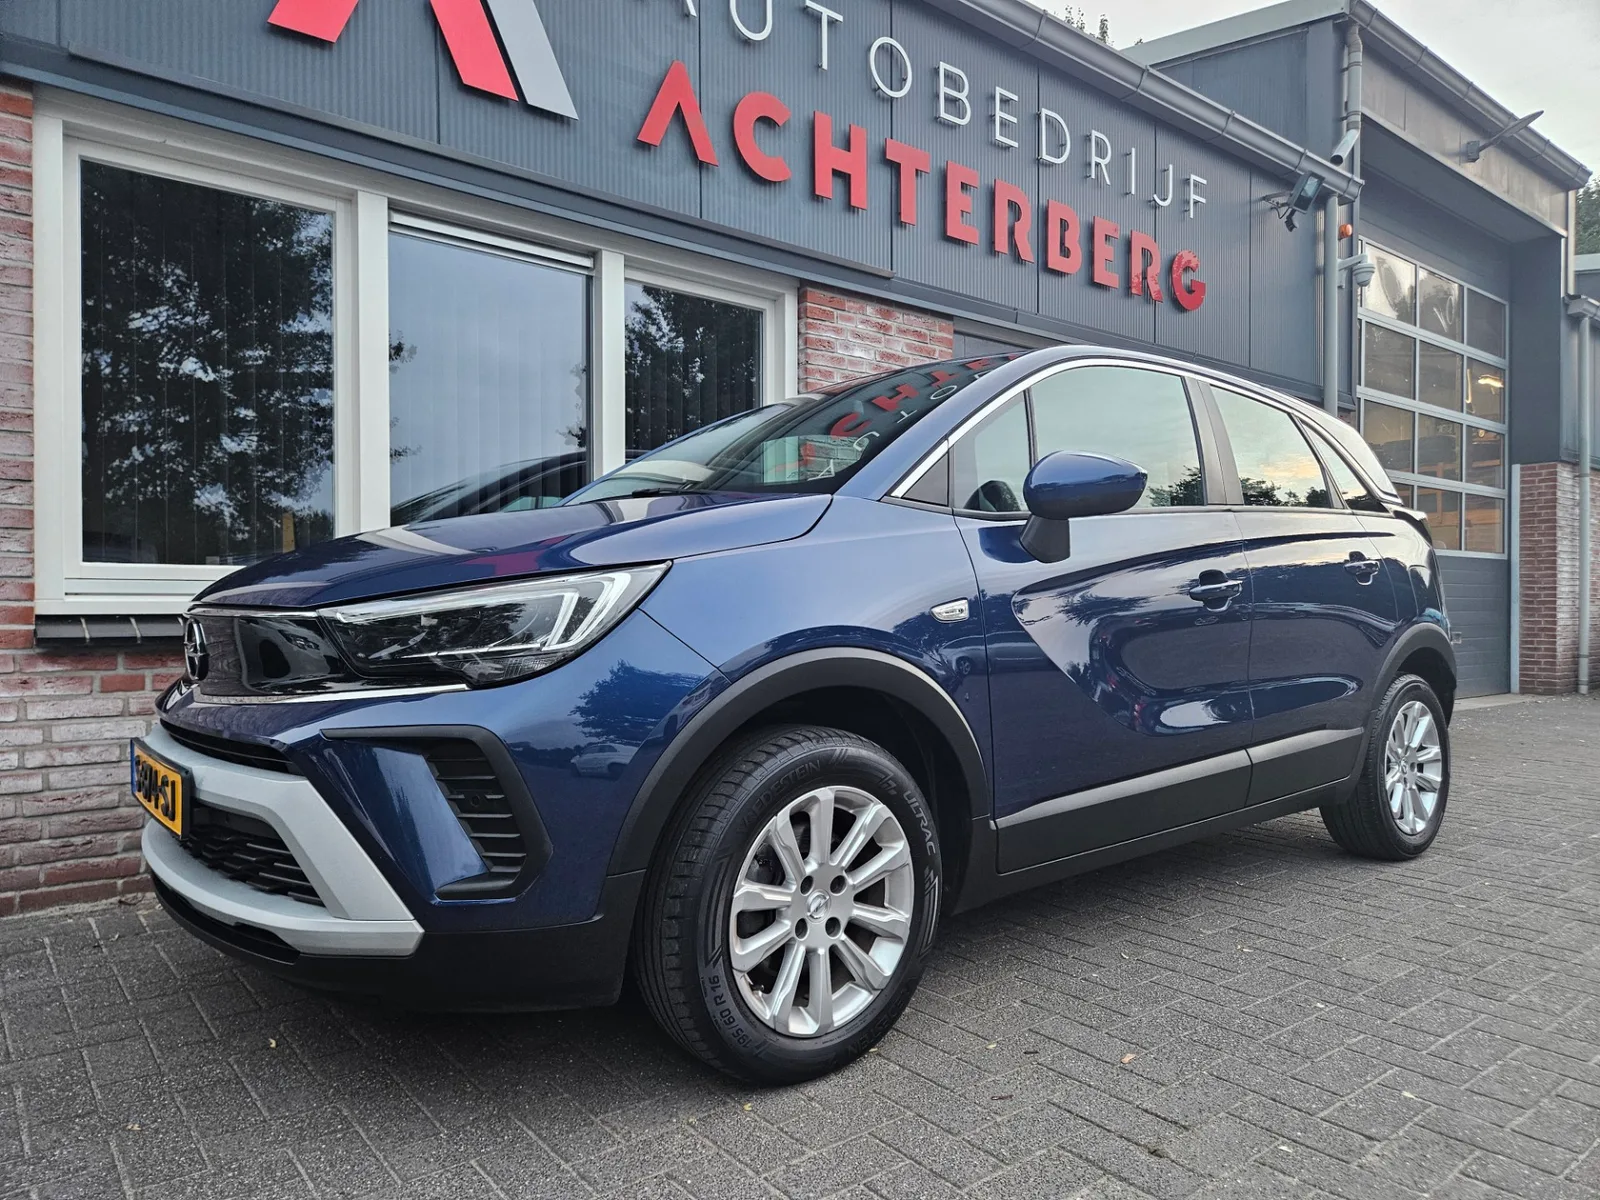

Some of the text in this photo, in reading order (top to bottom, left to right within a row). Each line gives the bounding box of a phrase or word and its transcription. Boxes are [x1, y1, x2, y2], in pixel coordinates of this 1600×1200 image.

[683, 0, 1207, 219] UTOBEDRIJF
[637, 60, 1207, 312] ACHTERBERG
[903, 790, 936, 856] ULTRAC
[719, 1008, 752, 1048] 195/60
